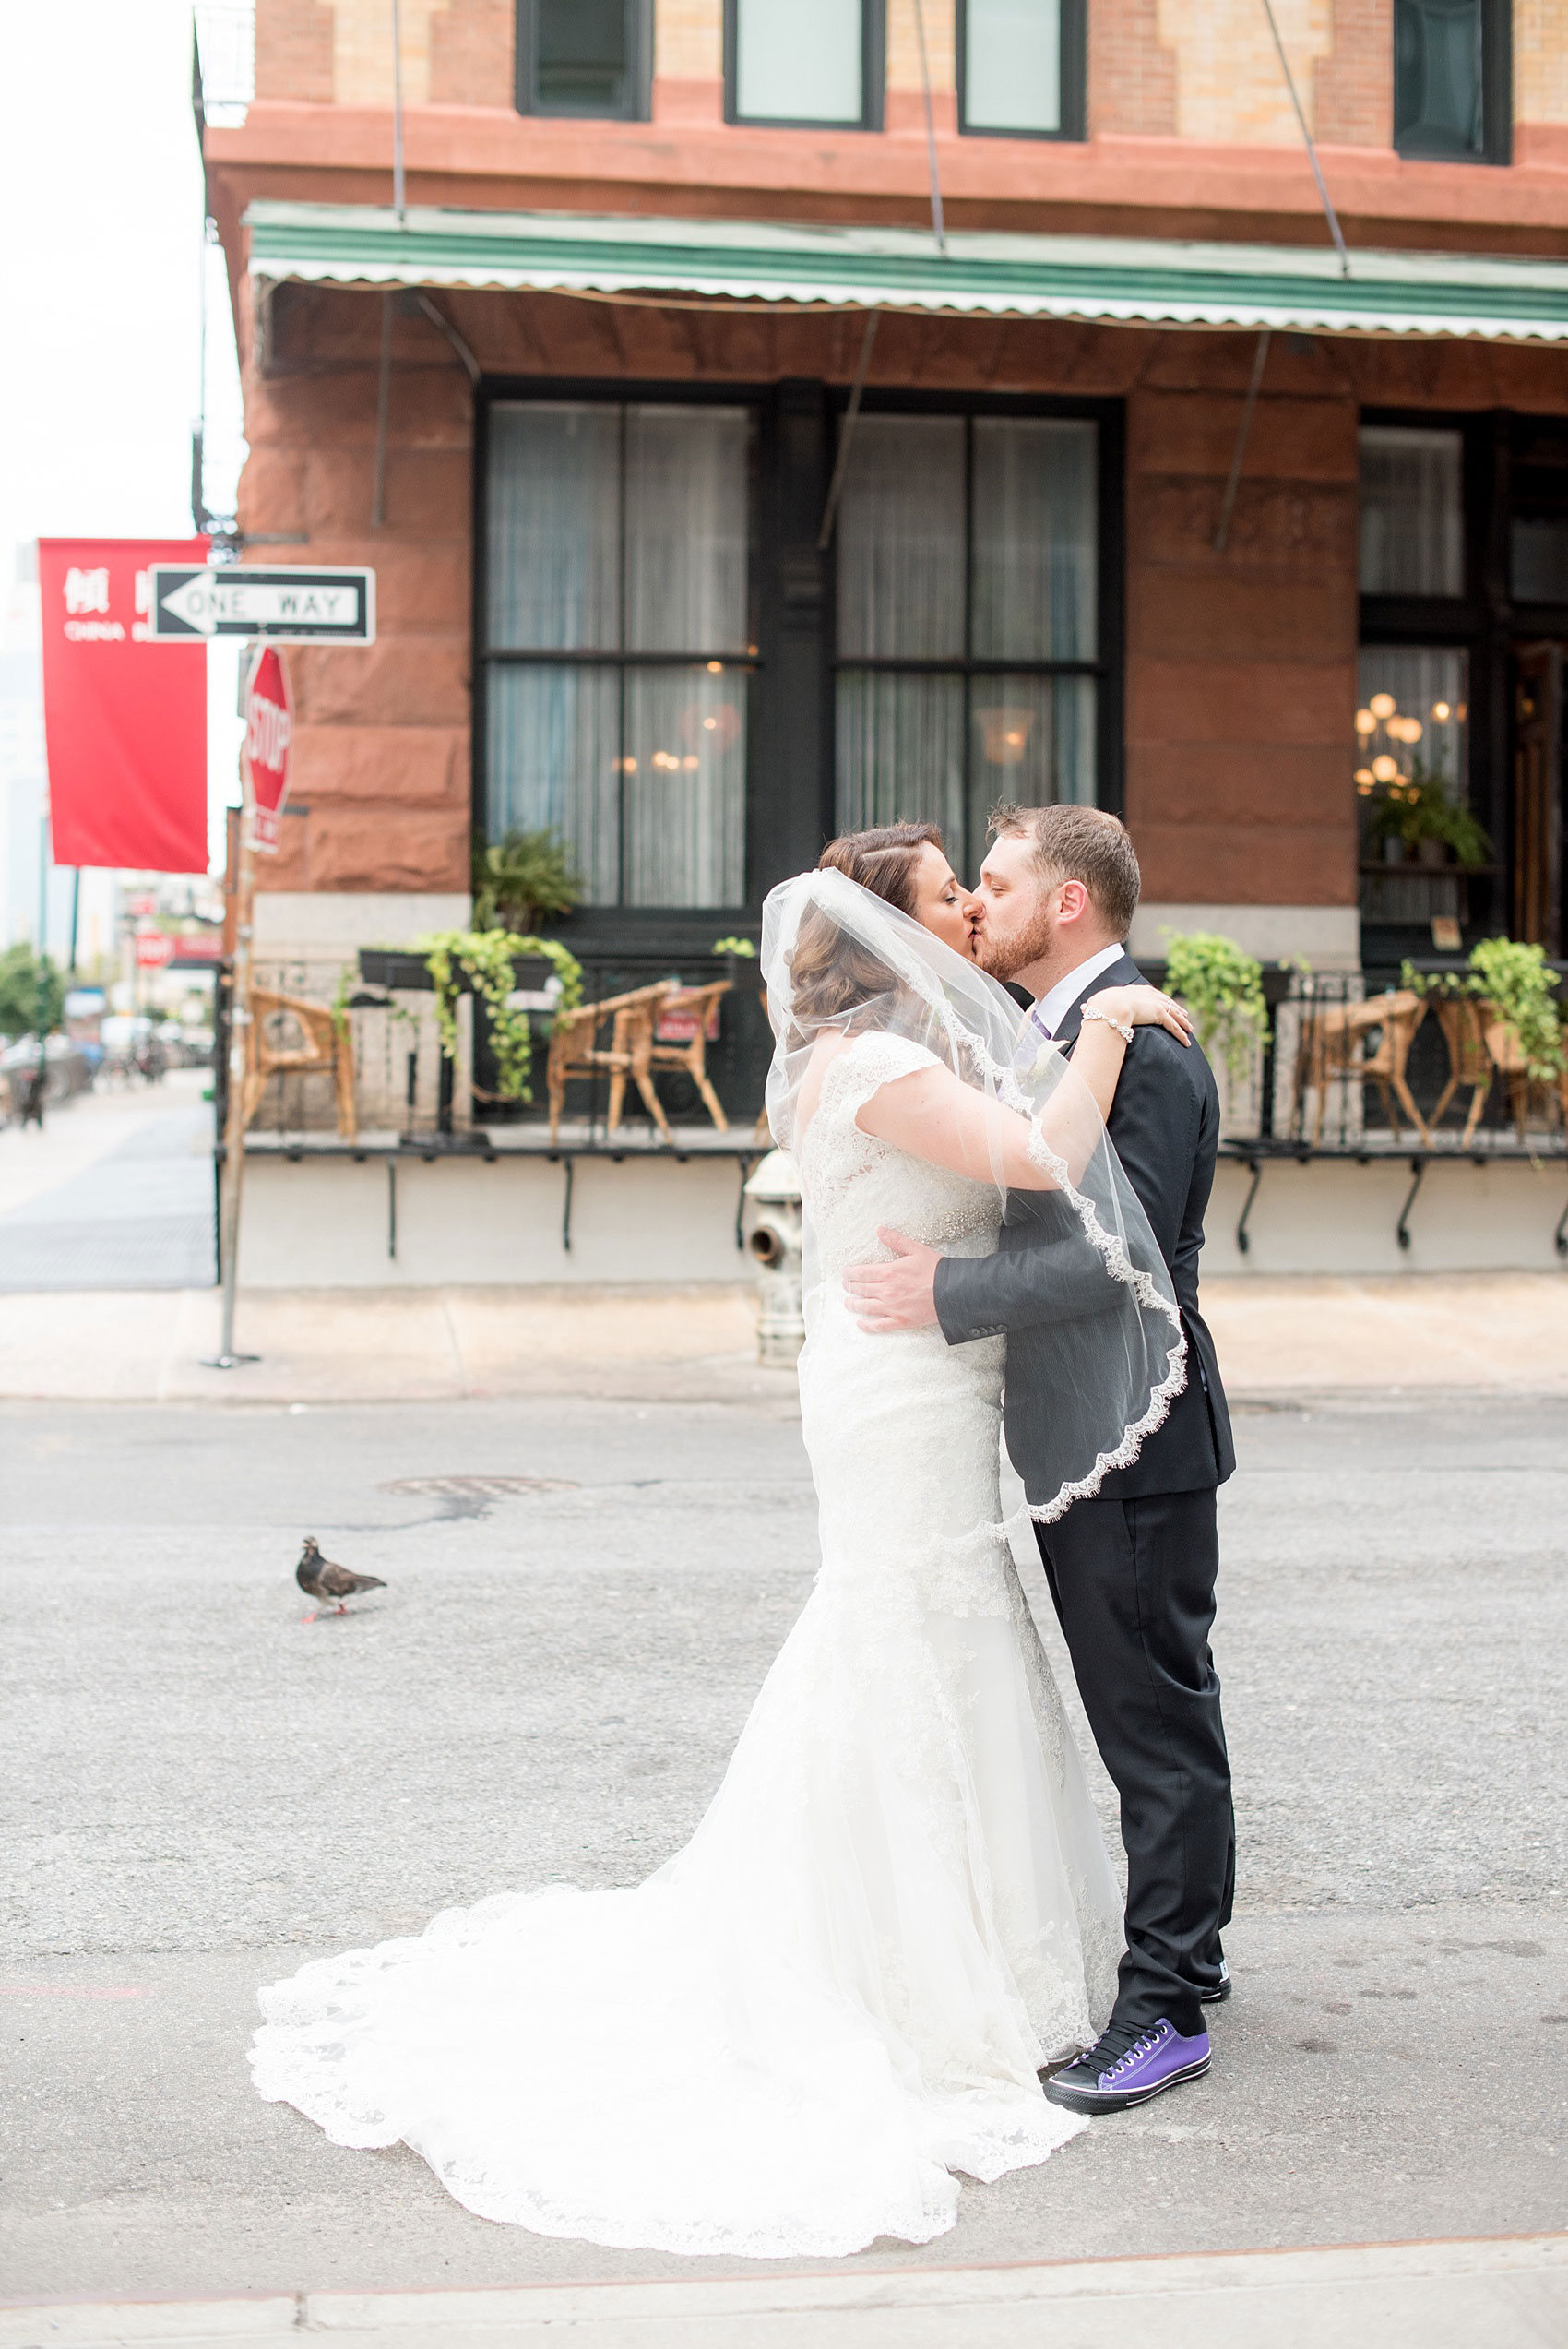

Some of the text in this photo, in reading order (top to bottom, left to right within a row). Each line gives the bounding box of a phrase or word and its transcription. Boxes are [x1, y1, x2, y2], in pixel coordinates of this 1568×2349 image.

[187, 590, 339, 616] ONE WAY
[64, 620, 125, 642] CHINA
[249, 695, 290, 773] STOP
